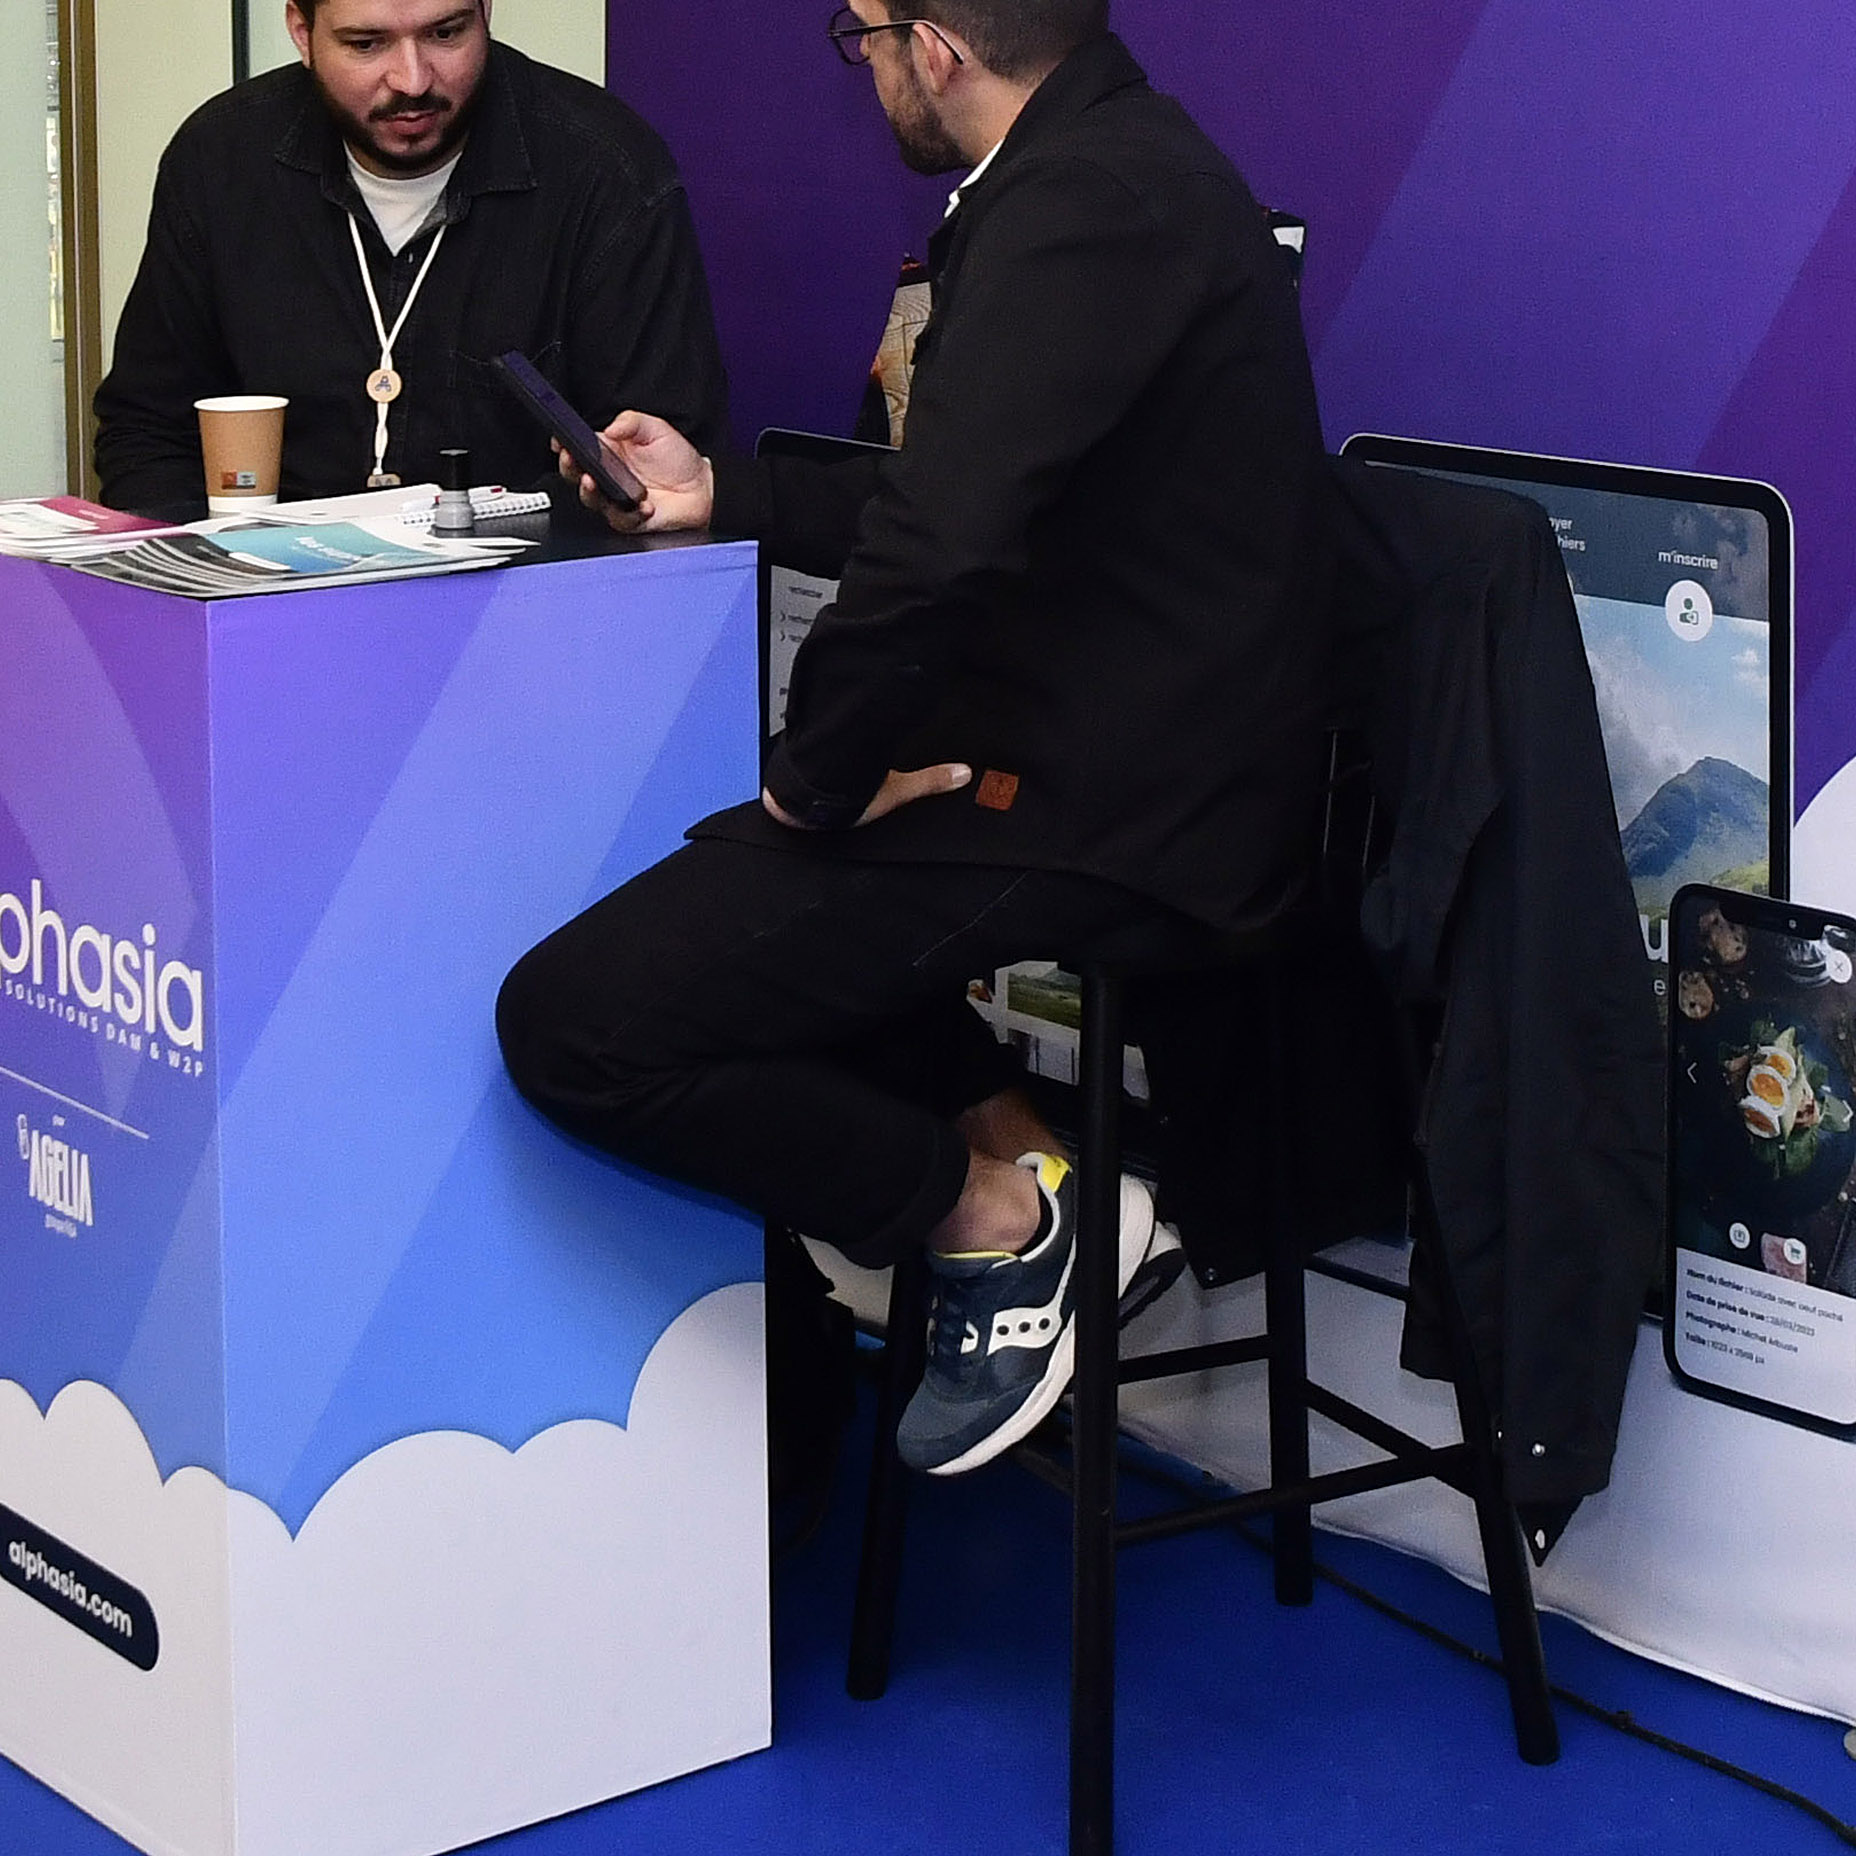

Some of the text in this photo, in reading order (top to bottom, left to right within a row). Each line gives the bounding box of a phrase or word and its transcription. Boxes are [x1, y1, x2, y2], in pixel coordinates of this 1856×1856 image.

[5, 978, 99, 1034] SOLUTIONS
[106, 1022, 142, 1052] DAM
[9, 1541, 133, 1637] alphasia.com
